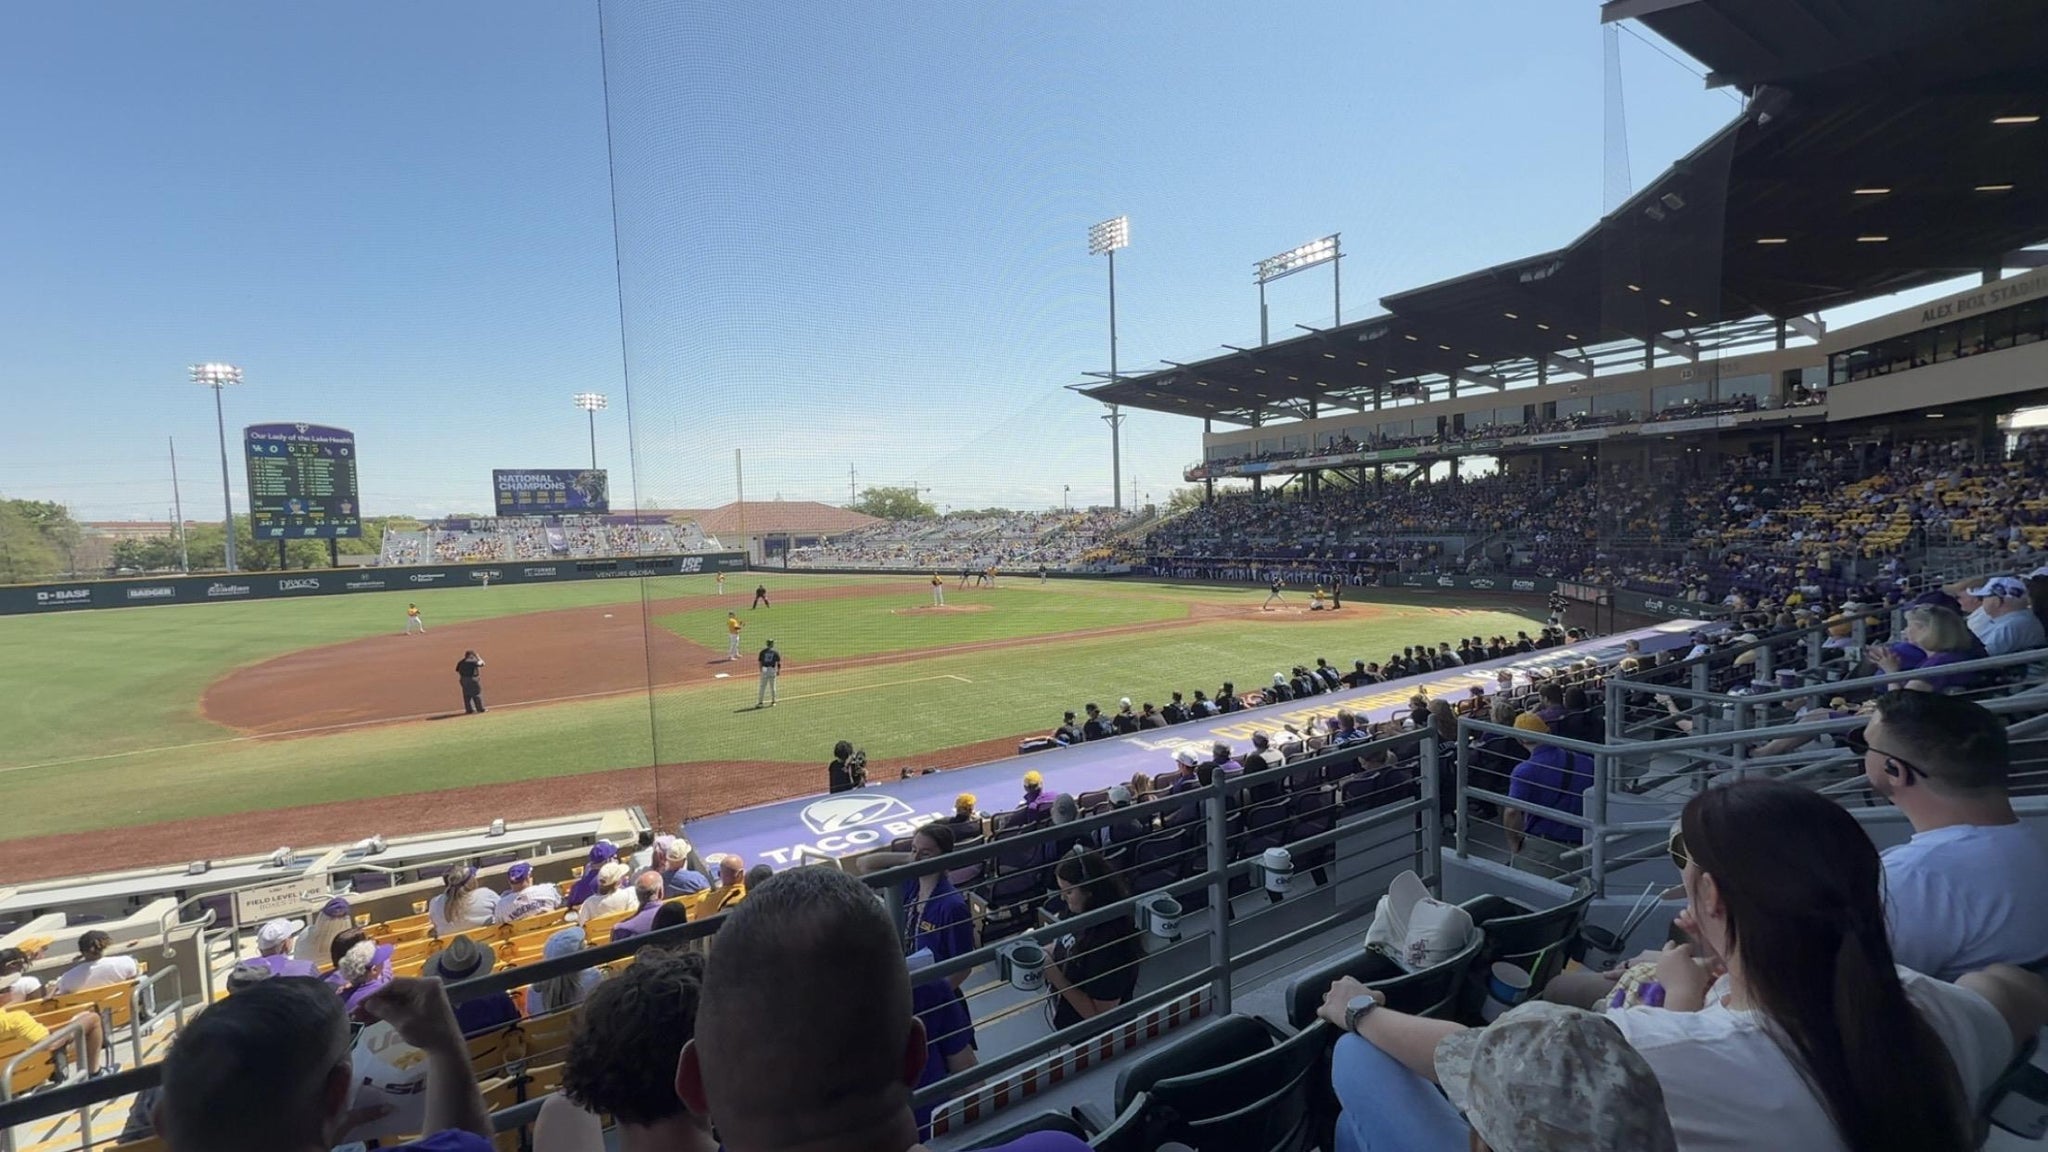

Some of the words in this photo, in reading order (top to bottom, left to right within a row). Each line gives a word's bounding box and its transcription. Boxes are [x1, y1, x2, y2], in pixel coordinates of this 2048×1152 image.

[1922, 304, 1953, 322] ALEX
[1957, 294, 1986, 313] BOX
[251, 431, 266, 440] Our
[268, 432, 287, 442] Lady
[288, 433, 297, 441] of
[312, 435, 329, 443] Lake
[329, 436, 353, 444] Health
[499, 482, 566, 490] CHAMPIONS
[470, 518, 541, 529] DIAMOND
[562, 517, 602, 527] DECK
[596, 570, 628, 578] VENTURE
[629, 569, 656, 577] GLOBAL
[1512, 579, 1535, 588] Acme
[56, 589, 90, 599] BASF
[759, 829, 880, 864] TACO
[246, 897, 271, 906] FIELD
[271, 892, 298, 901] LEVEL
